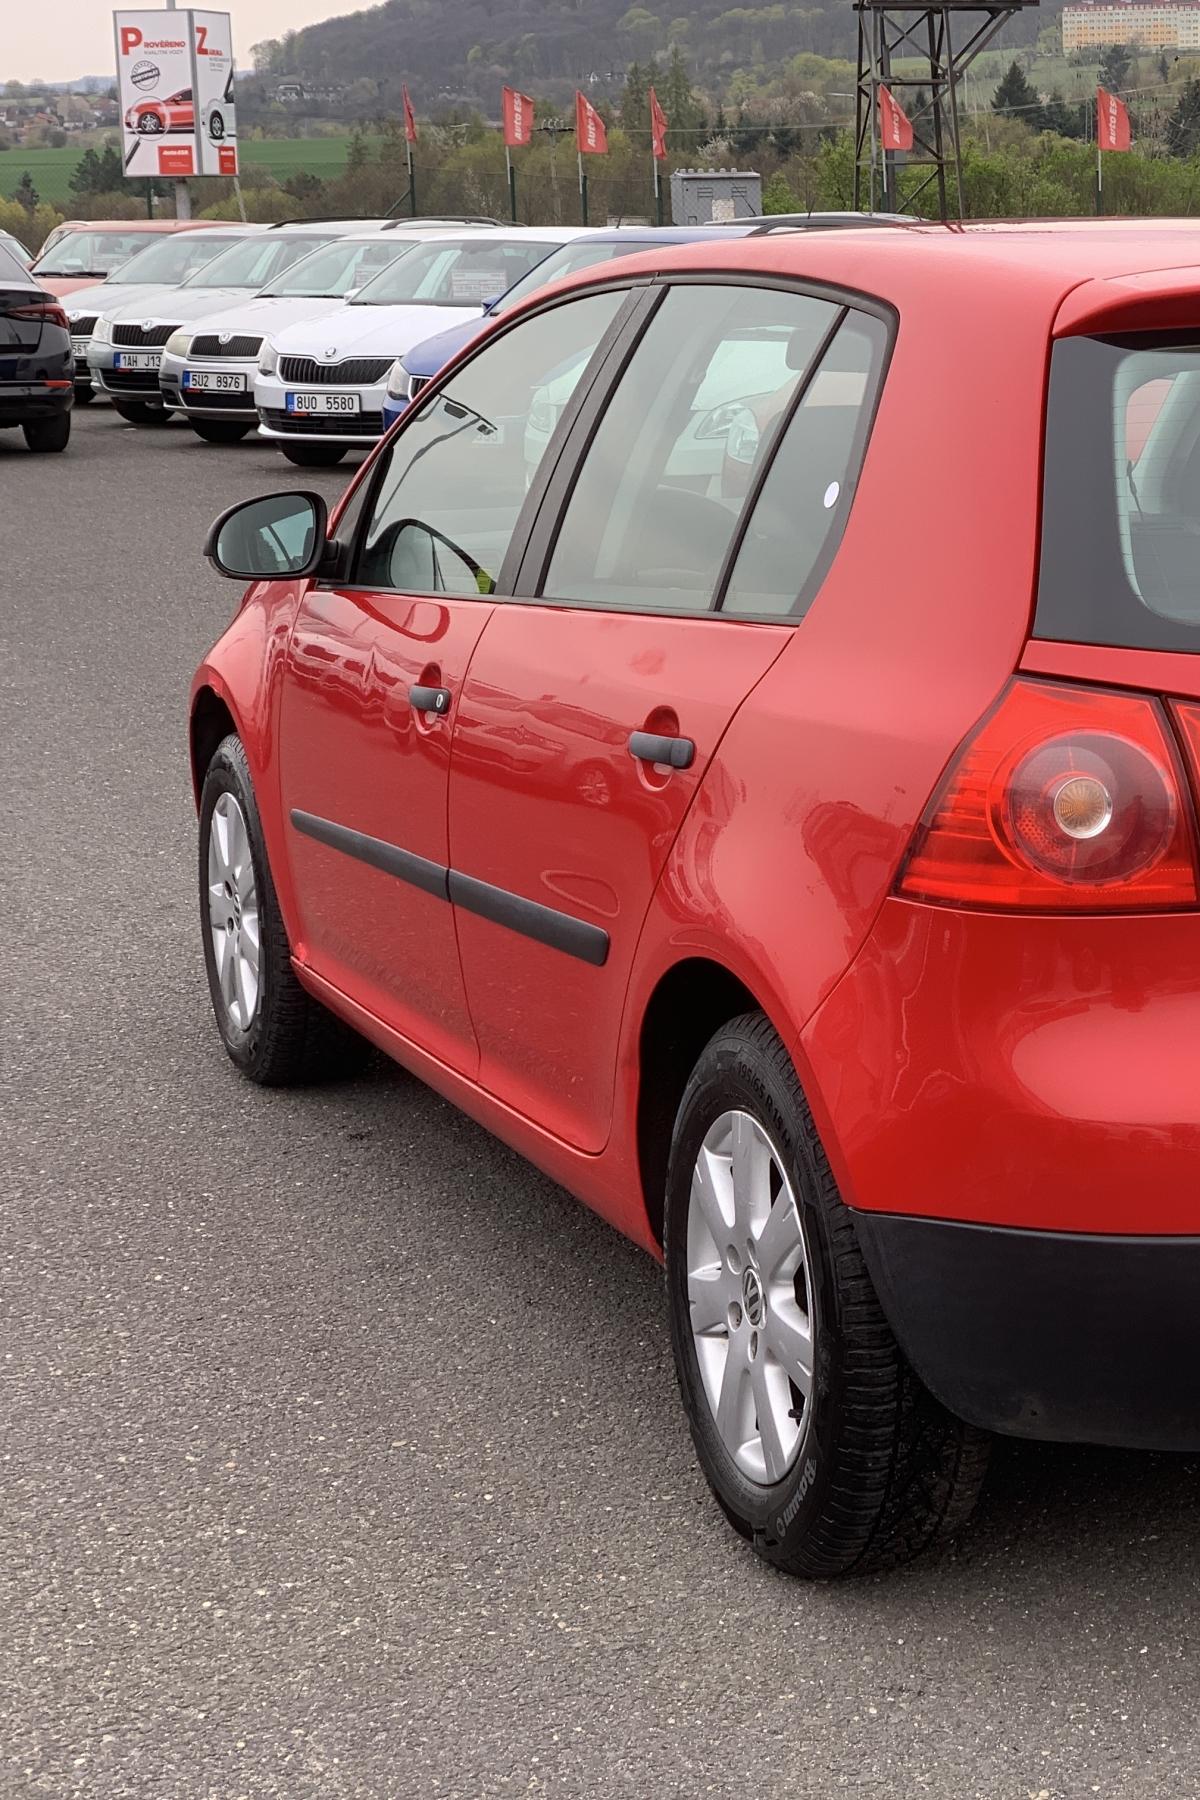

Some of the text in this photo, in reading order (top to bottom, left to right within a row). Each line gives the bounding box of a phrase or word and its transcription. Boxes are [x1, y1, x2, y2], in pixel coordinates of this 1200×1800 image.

[514, 112, 522, 141] Auto
[1109, 115, 1117, 145] Auto
[122, 355, 138, 366] 1AH
[191, 375, 240, 389] 5U2 8976
[326, 396, 354, 410] 5580
